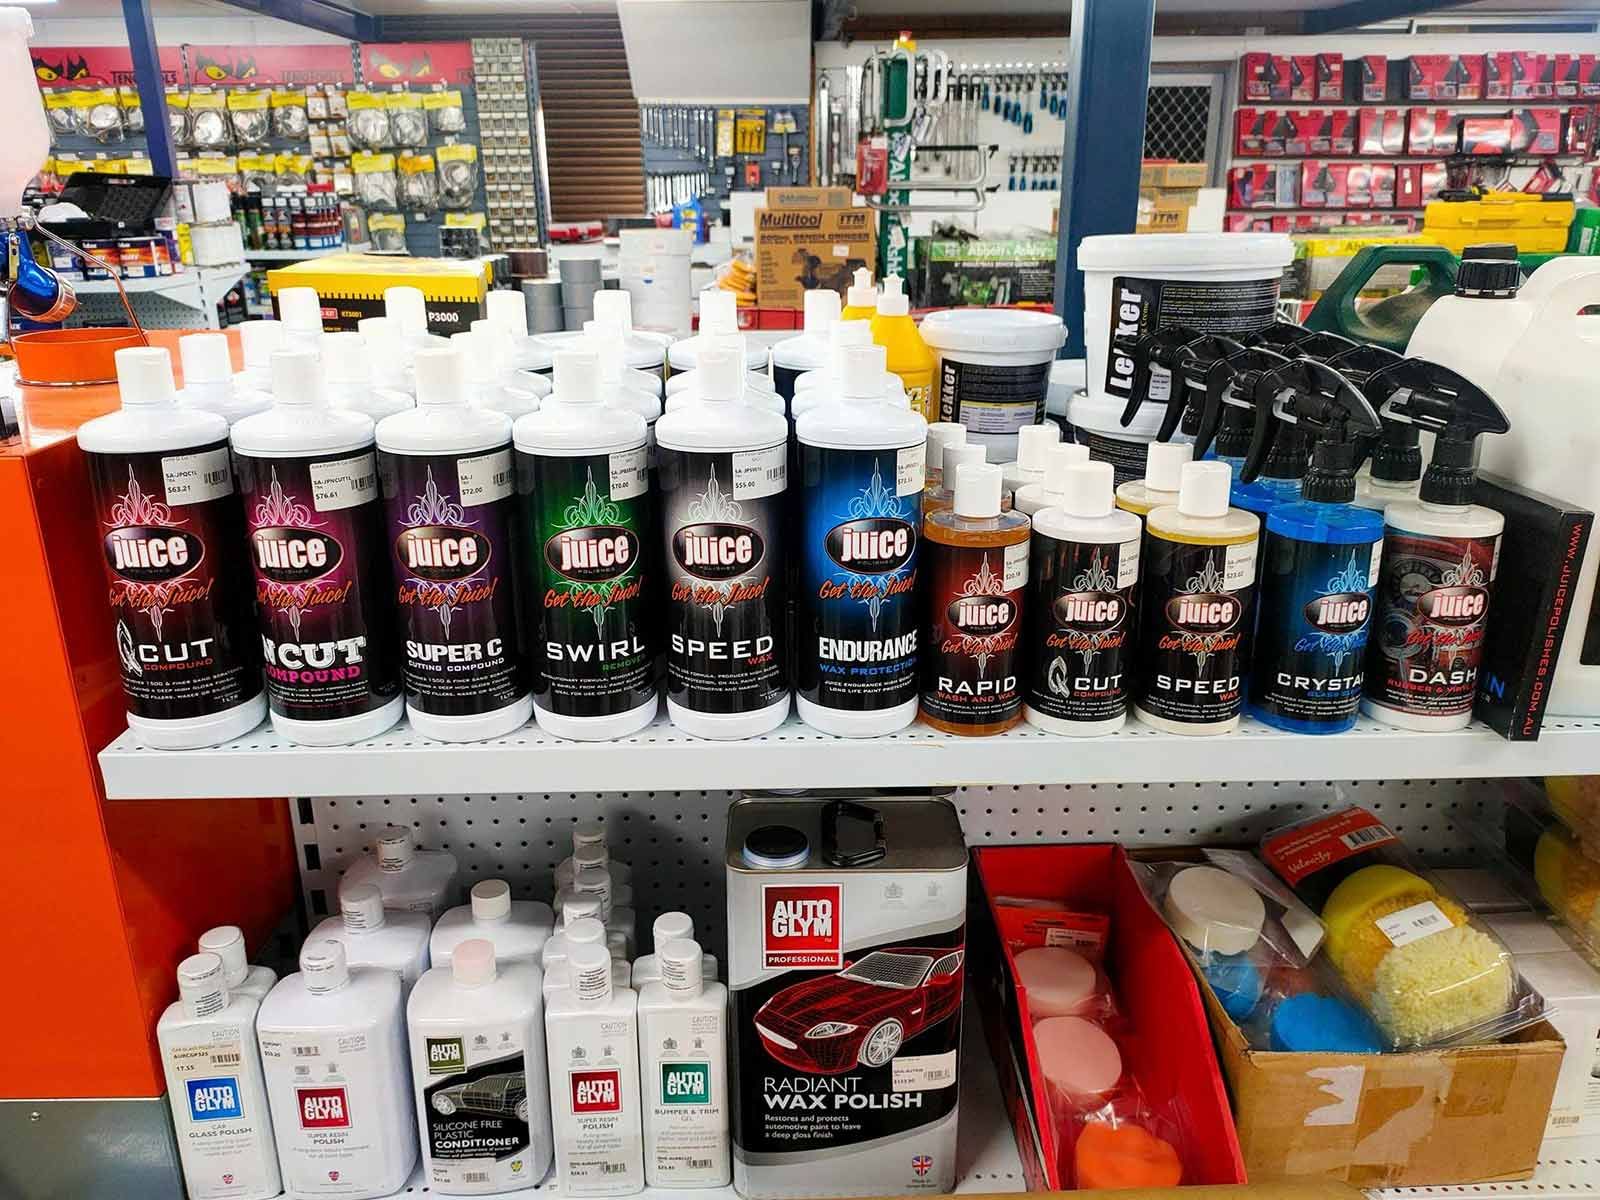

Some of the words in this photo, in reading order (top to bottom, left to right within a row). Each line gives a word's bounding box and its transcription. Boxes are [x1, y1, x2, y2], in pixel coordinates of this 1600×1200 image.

[760, 213, 823, 228] Multitool
[840, 214, 865, 225] ITM
[1154, 212, 1179, 224] ITM
[428, 311, 459, 322] P3000
[1109, 287, 1142, 390] Leker
[112, 535, 188, 569] juice
[258, 535, 327, 569] juice
[407, 535, 479, 568] juice
[560, 535, 630, 571] juice
[684, 531, 753, 566] juice
[841, 528, 909, 562] juice
[820, 580, 845, 599] Get
[544, 588, 568, 608] Get
[1430, 591, 1484, 618] juice
[957, 601, 1010, 627] juice
[1065, 599, 1119, 622] juice
[1177, 600, 1233, 623] juice
[1318, 599, 1367, 626] juice
[1522, 522, 1584, 736] WWW.JUICEPOLISHES.COM.AU
[117, 618, 144, 677] Q
[138, 638, 214, 663] CUT
[546, 636, 646, 663] SWIRL
[671, 634, 774, 660] SPEED
[820, 629, 918, 663] ENDURANCE
[941, 638, 961, 654] Get
[1046, 635, 1066, 649] Get
[1158, 636, 1179, 650] Get
[406, 640, 482, 663] SUPER
[487, 638, 503, 657] C
[144, 658, 214, 671] COMPOUND
[408, 660, 442, 672] CUTTING
[447, 657, 505, 672] COMPOUND
[602, 655, 643, 671] REMOVE
[747, 654, 773, 666] WAX
[820, 663, 846, 676] WAX
[850, 657, 916, 676] PROTECTIO
[1047, 656, 1070, 698] Q
[1074, 674, 1123, 691] CUT
[1408, 667, 1477, 685] DASH
[938, 677, 1017, 696] RAPID
[1156, 674, 1240, 695] SPEED
[1387, 679, 1433, 692] RUBBER
[937, 691, 967, 703] WASH
[1073, 688, 1121, 698] COMPOUND
[1219, 690, 1239, 702] WAX
[772, 899, 832, 920] AUTO
[771, 917, 832, 938] GLYM
[768, 955, 836, 965] PROFESSIONAL
[430, 1043, 458, 1055] AUTO
[430, 1051, 460, 1062] GLYM
[668, 1071, 704, 1085] AUTO
[764, 1077, 862, 1093] RADIANT
[195, 1086, 233, 1102] AUTO
[577, 1080, 614, 1094] AUTO
[667, 1082, 704, 1096] GLYM
[195, 1098, 236, 1113] GLYM
[304, 1096, 340, 1110] AUTO
[577, 1091, 615, 1105] GLYM
[763, 1094, 827, 1110] WAX
[835, 1093, 922, 1109] POLISH
[304, 1107, 342, 1120] GLYM
[764, 1114, 799, 1123] Restores
[801, 1114, 815, 1122] and
[816, 1114, 849, 1124] protects
[219, 1127, 252, 1136] POLISH
[433, 1120, 479, 1132] SILICONE
[480, 1119, 503, 1129] FREE
[765, 1122, 808, 1131] automotive
[810, 1122, 829, 1132] paint
[831, 1123, 840, 1131] to
[842, 1122, 861, 1131] leave
[434, 1130, 474, 1140] PLASTIC
[435, 1137, 520, 1149] CONDITIONER
[771, 1131, 790, 1141] deep
[792, 1131, 811, 1141] gloss
[813, 1130, 833, 1139] finish
